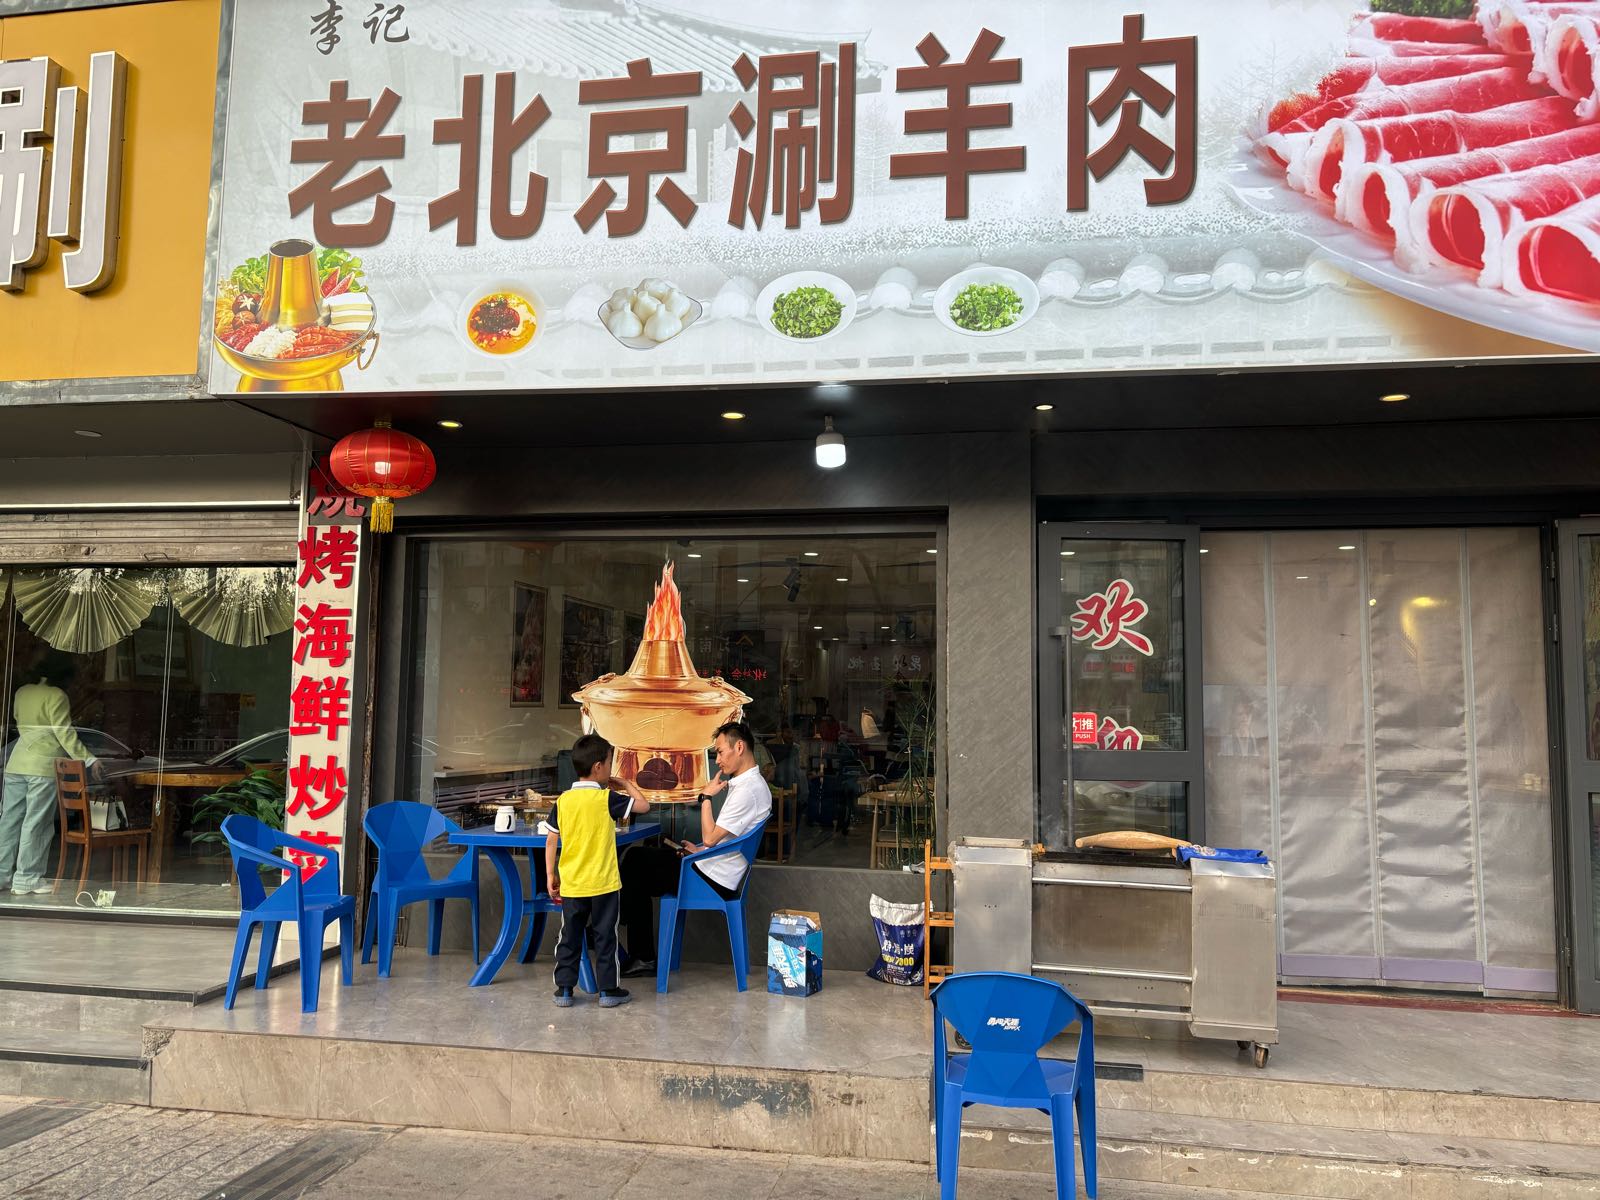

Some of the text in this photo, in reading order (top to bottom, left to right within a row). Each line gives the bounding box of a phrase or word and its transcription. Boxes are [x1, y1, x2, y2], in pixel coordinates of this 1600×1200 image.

[310, 0, 409, 55] 李记
[288, 13, 1198, 248] 老北京涮羊肉
[1082, 718, 1094, 730] 推
